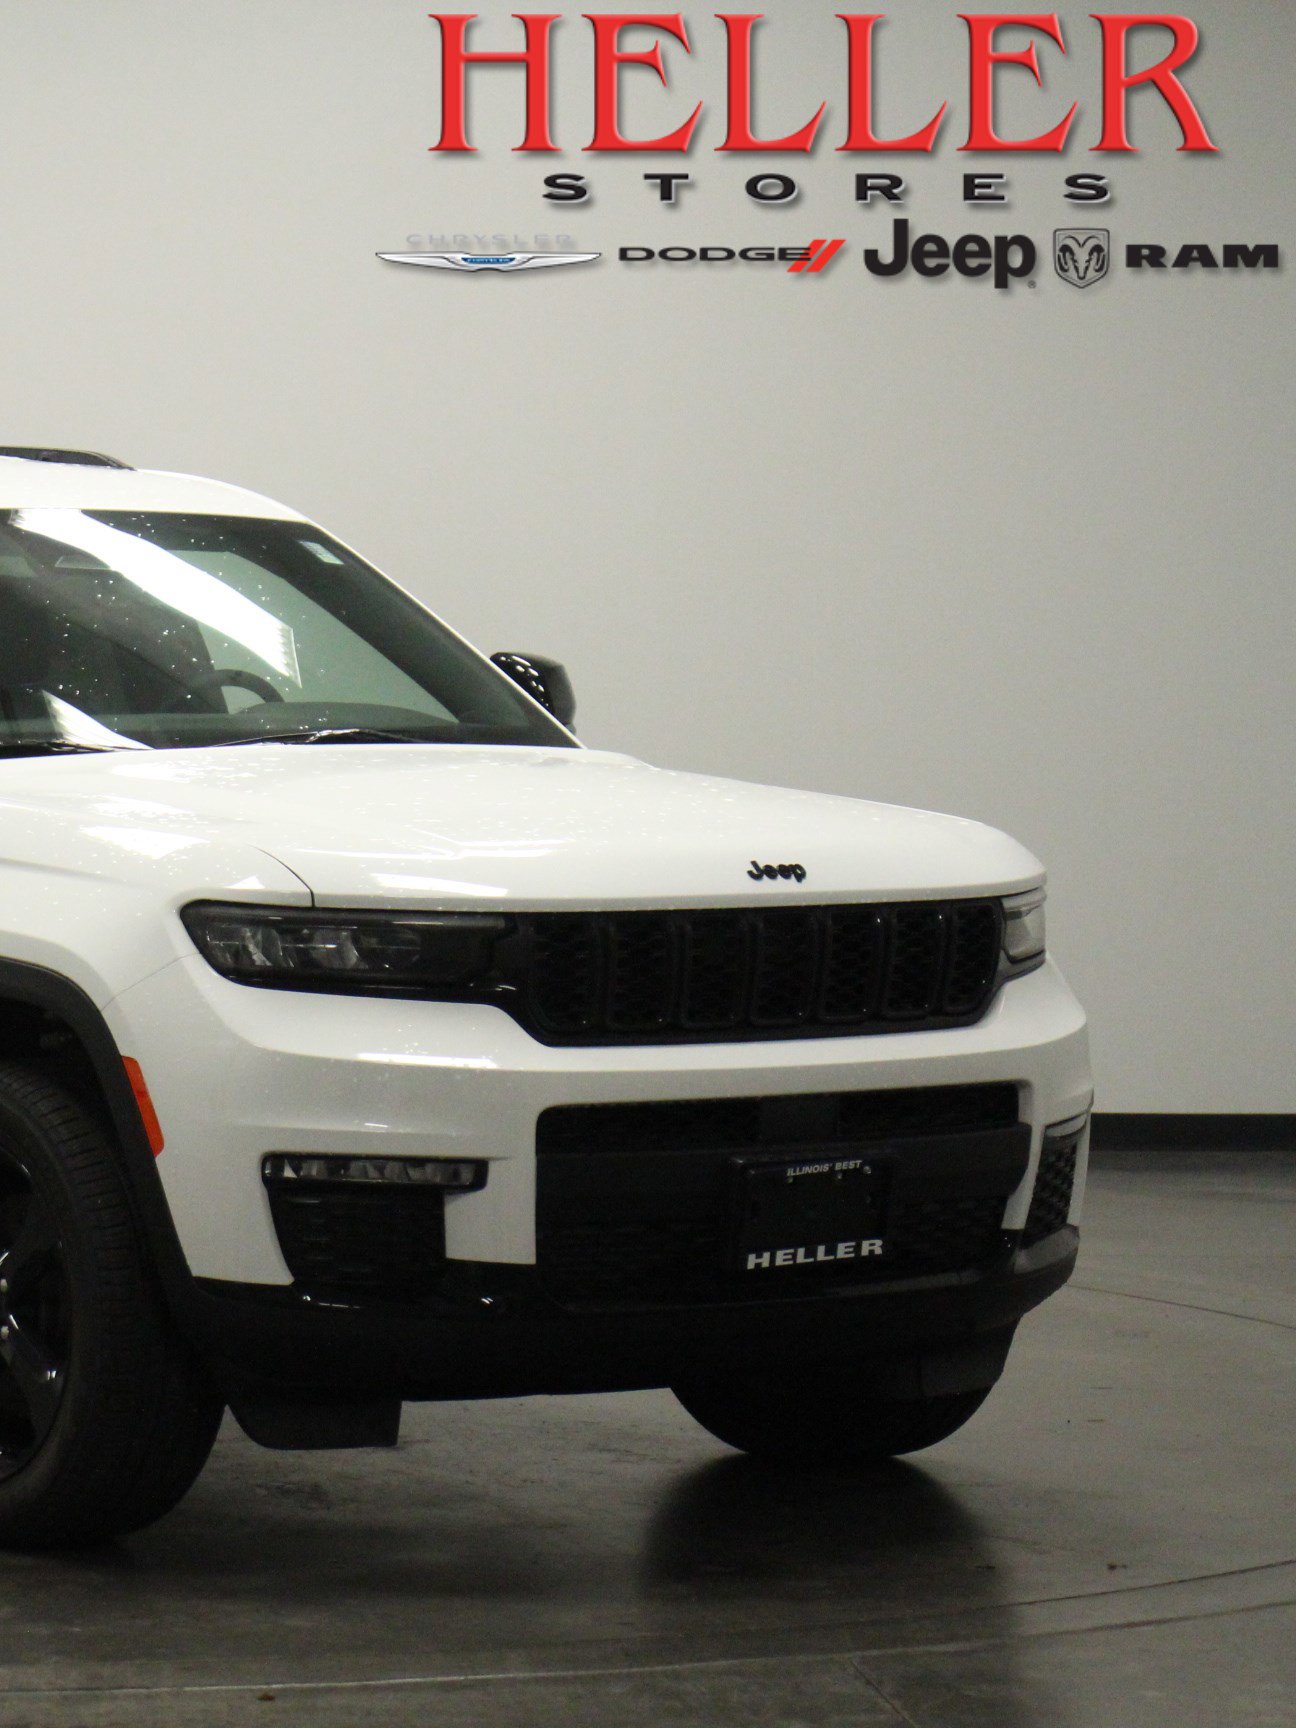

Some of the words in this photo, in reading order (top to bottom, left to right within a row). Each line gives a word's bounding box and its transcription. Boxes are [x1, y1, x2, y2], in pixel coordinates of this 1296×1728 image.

[746, 860, 807, 883] Jeep
[835, 1160, 862, 1171] BEST
[746, 1239, 883, 1270] HELLER
